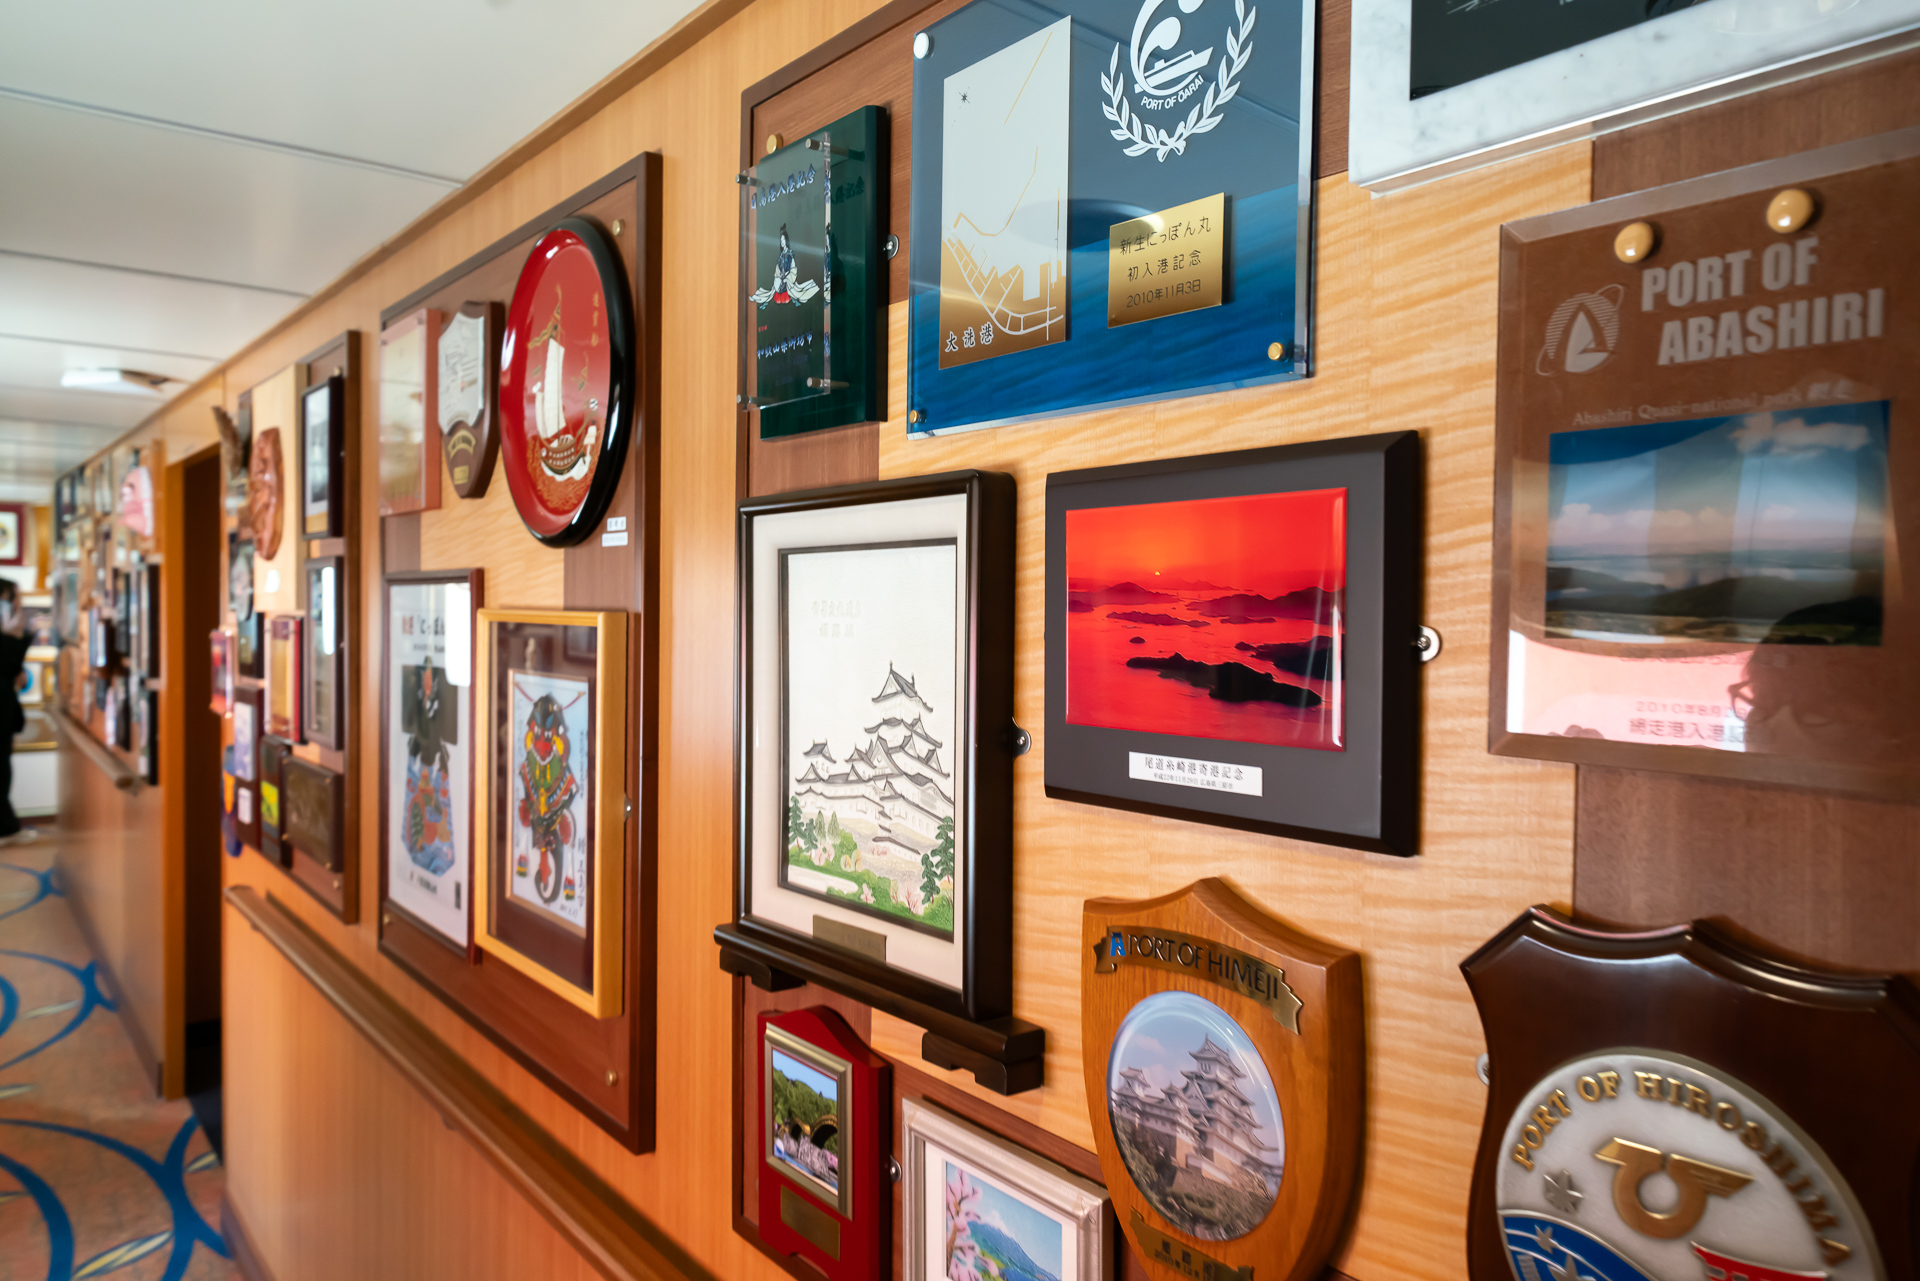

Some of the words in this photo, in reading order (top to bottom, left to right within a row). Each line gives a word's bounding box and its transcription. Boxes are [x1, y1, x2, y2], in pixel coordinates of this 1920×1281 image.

[1141, 96, 1164, 110] PORT
[1165, 95, 1177, 109] OF
[1120, 216, 1212, 256] 新生にっぽん丸
[1127, 249, 1202, 282] 初入港記念
[1641, 250, 1752, 312] PORT
[1762, 237, 1819, 292] OF
[1126, 279, 1201, 308] 2010年11月3日
[945, 321, 994, 352] 大洗港
[1658, 289, 1884, 365] ABASHIRI
[1572, 406, 1633, 426] Abashiri
[1145, 756, 1244, 781] 尾道糸崎港寄港記念
[1128, 934, 1176, 962] PORT
[1177, 942, 1204, 970] OF
[1208, 949, 1279, 1001] HIMEJI
[1511, 1089, 1572, 1172] PORT
[1576, 1071, 1621, 1103] OF
[1634, 1071, 1852, 1266] HIROSHIMA
